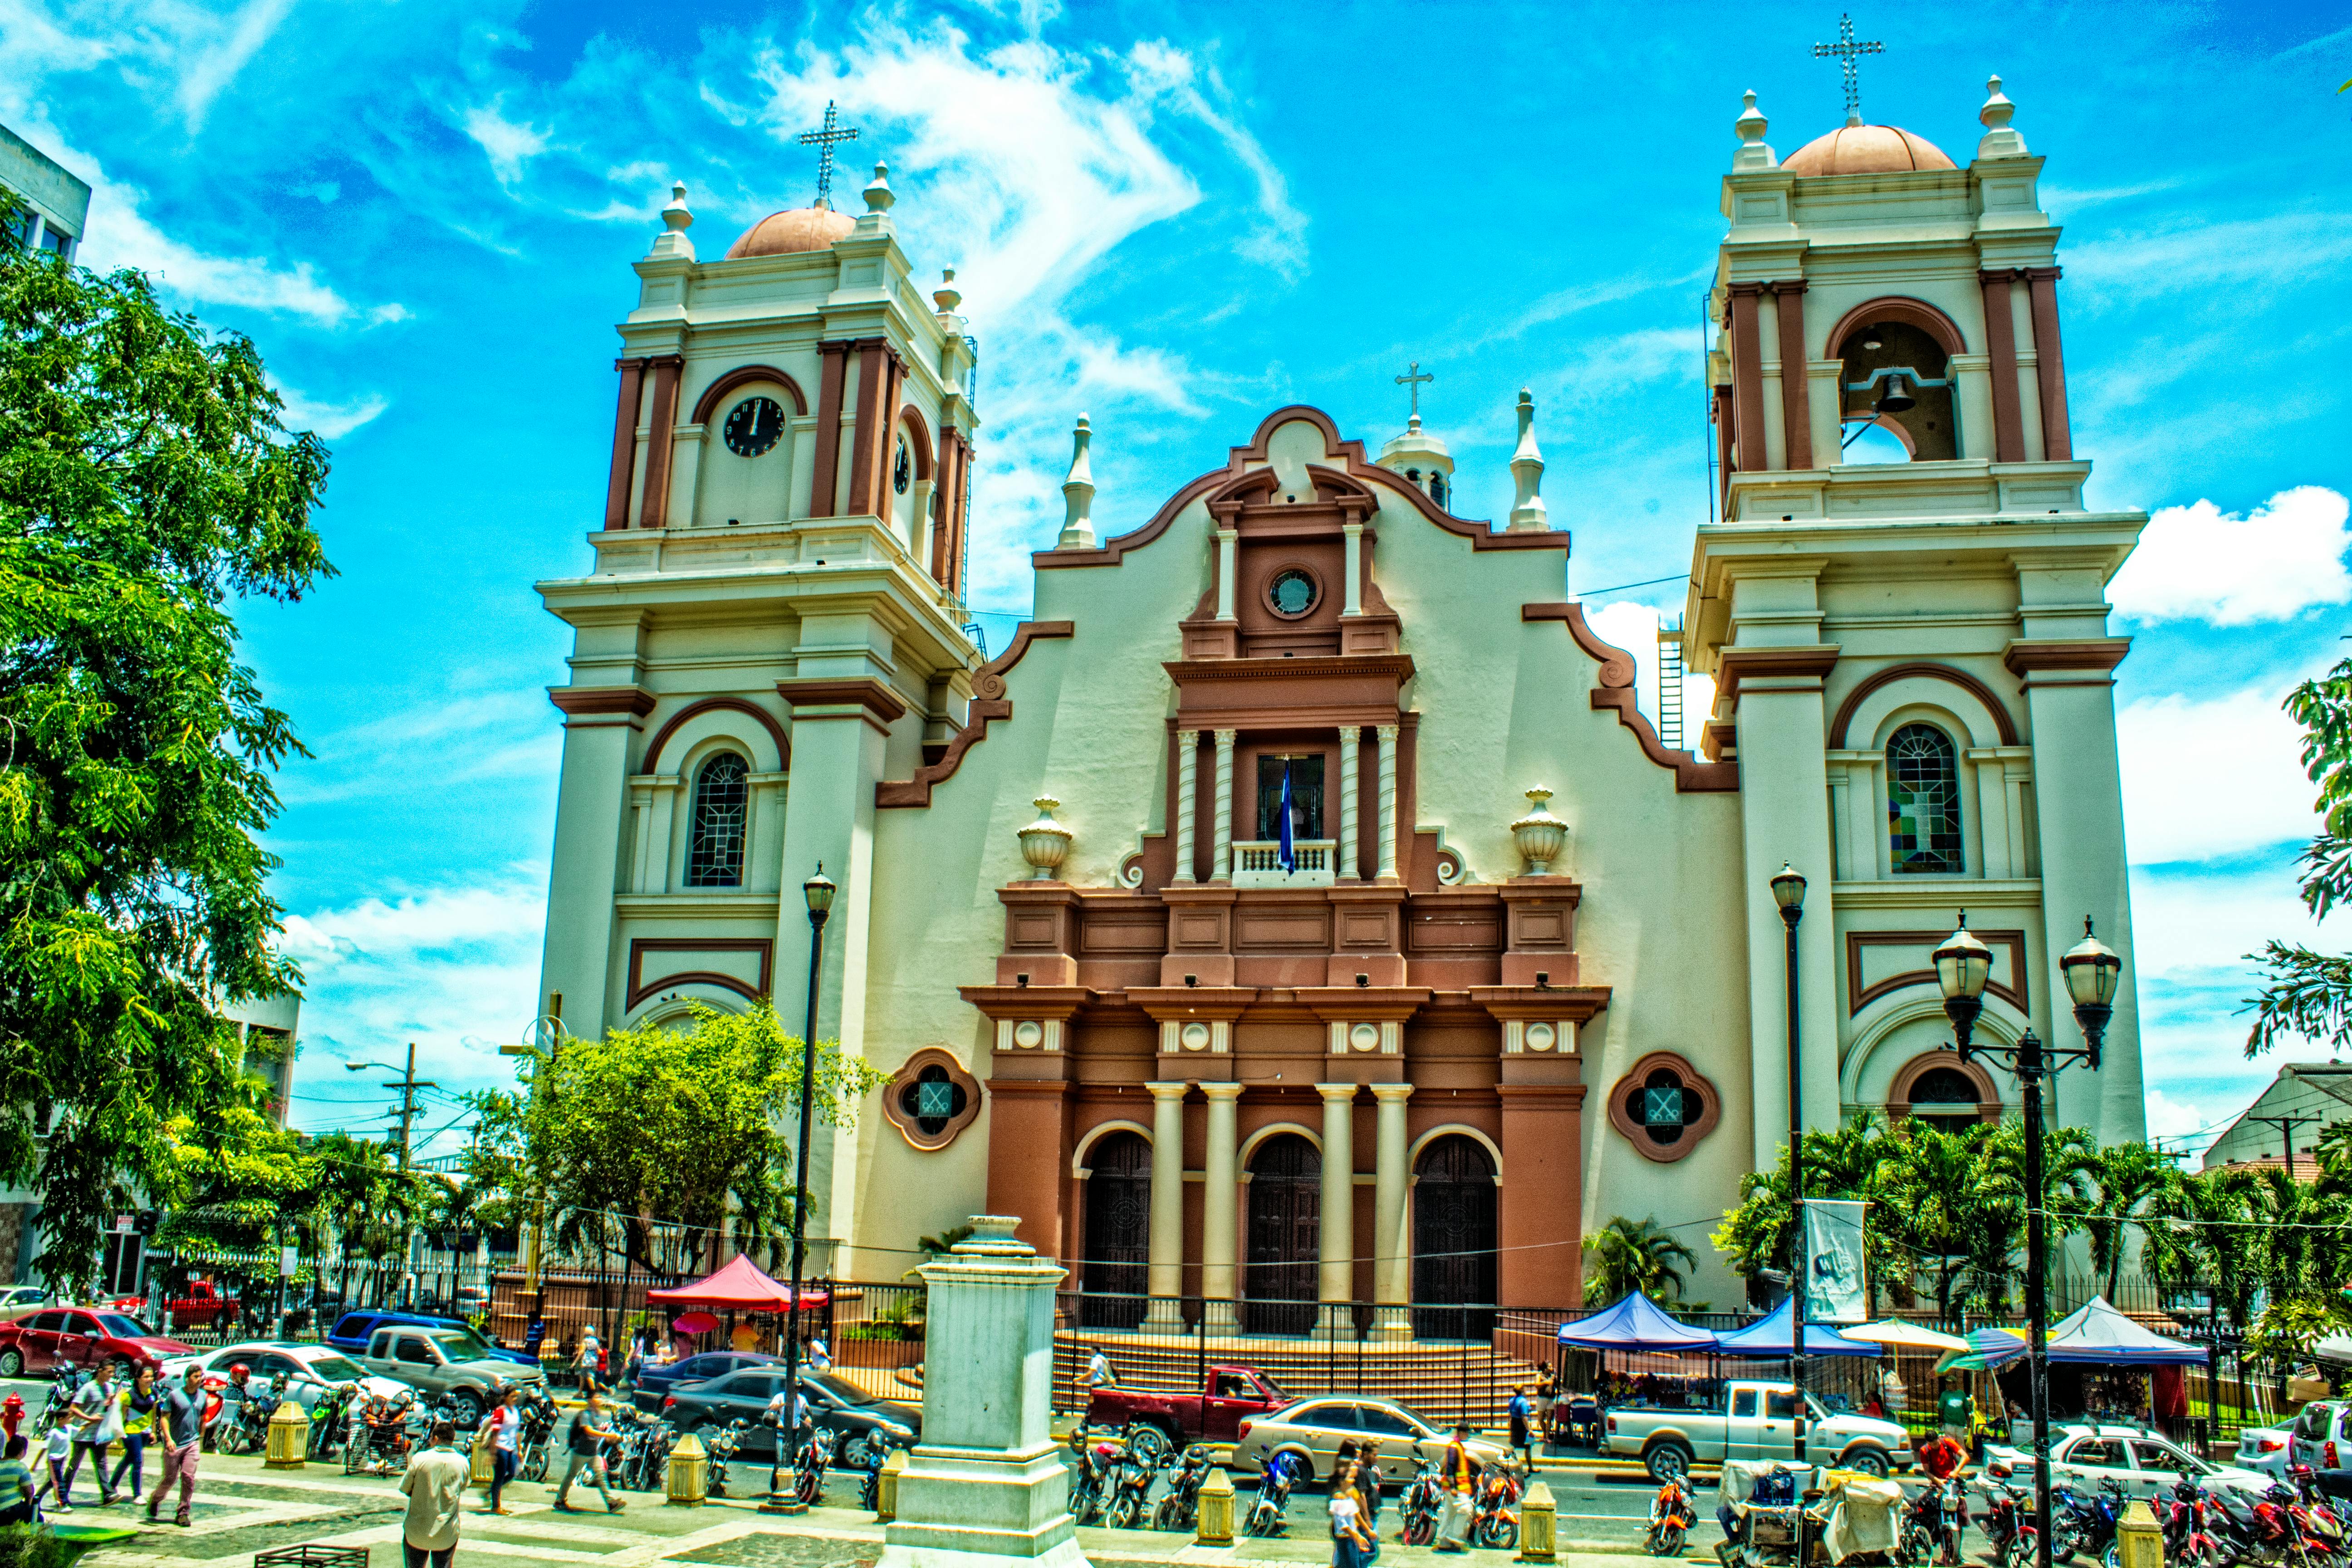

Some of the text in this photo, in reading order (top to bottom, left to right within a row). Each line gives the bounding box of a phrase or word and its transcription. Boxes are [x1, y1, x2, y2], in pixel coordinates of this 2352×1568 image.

[742, 404, 748, 412] 11
[768, 402, 771, 410] 1
[733, 412, 740, 421] 10
[776, 409, 781, 417] 2
[727, 426, 732, 435] 9
[778, 422, 784, 431] 3
[730, 438, 734, 447] 8
[739, 446, 744, 456] 7
[750, 448, 755, 457] 6
[763, 444, 769, 453] 5
